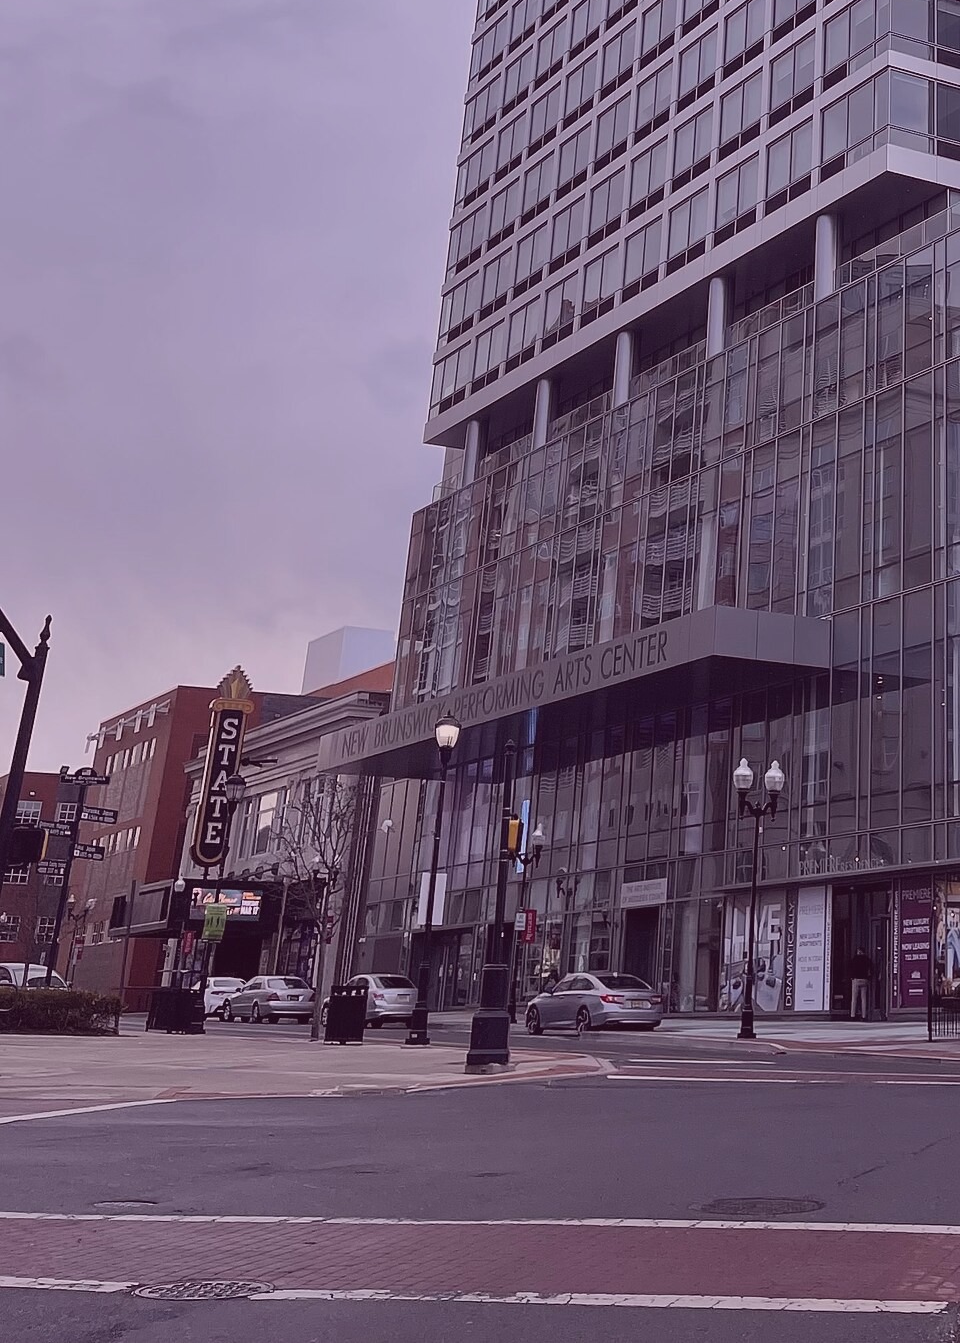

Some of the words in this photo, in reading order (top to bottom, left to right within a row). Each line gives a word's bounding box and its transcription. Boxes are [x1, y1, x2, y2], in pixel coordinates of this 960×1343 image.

[342, 723, 369, 759] NEW
[454, 669, 544, 722] PERFORMING
[553, 654, 592, 695] ARTS
[601, 630, 668, 680] CENTER
[204, 718, 239, 844] STATE
